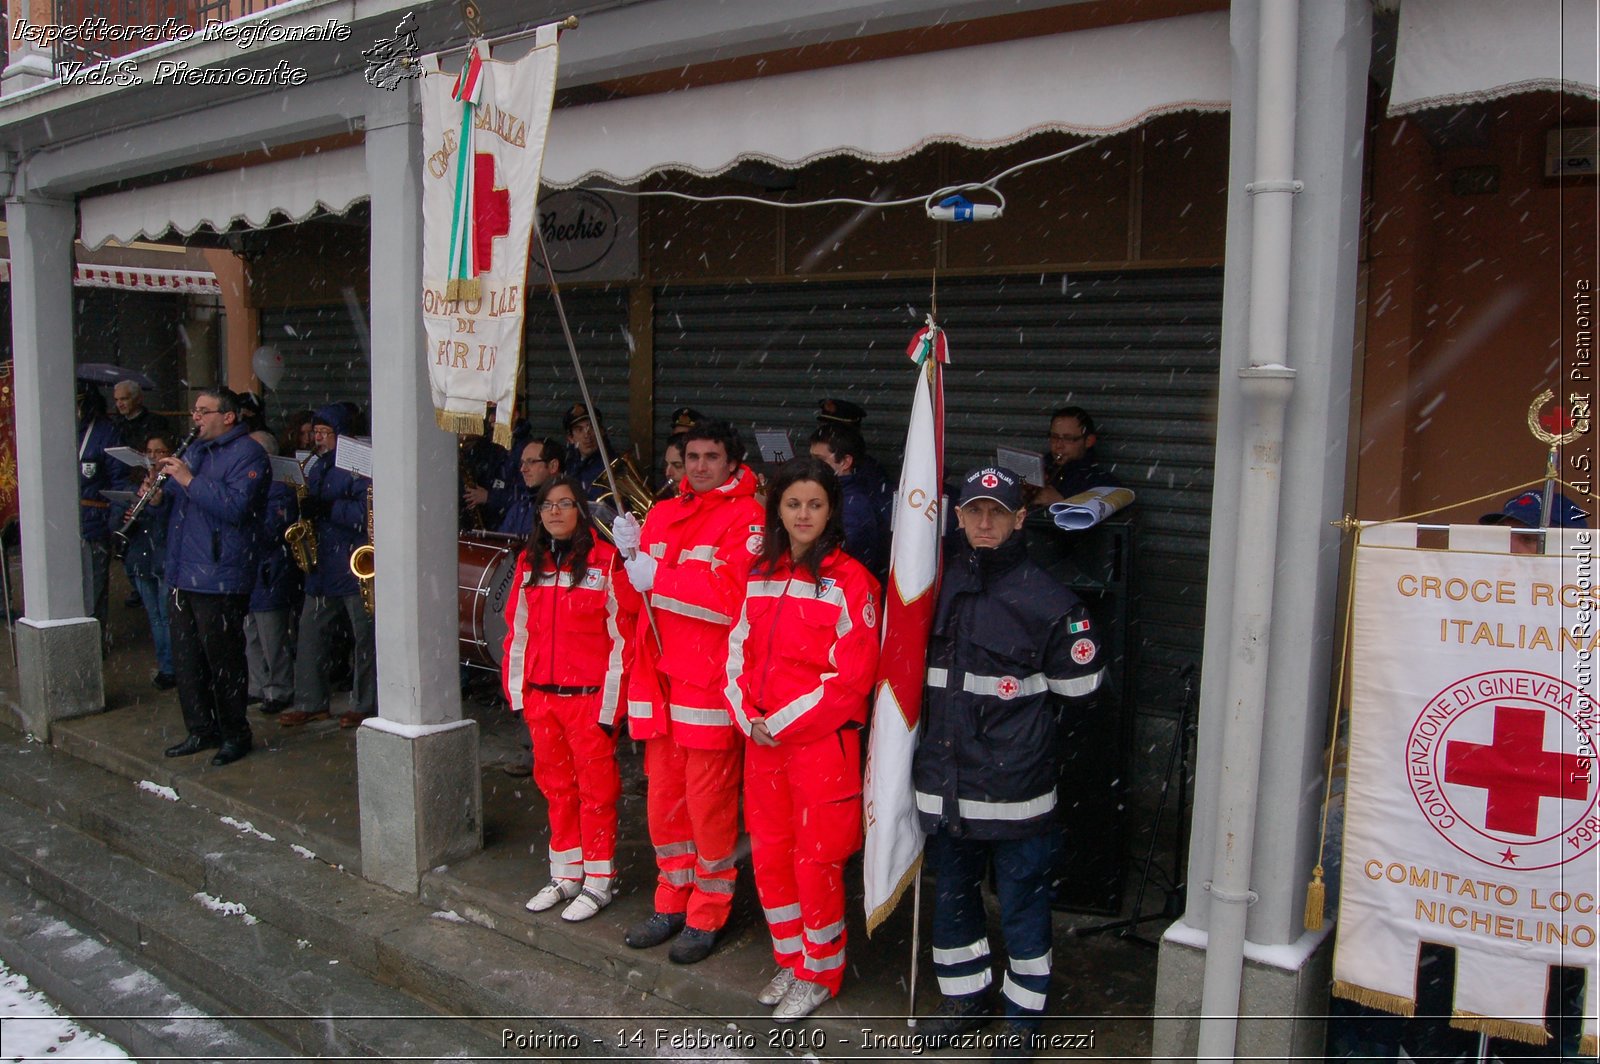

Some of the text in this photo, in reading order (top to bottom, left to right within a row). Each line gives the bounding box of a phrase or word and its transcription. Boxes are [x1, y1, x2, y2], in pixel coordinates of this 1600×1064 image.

[456, 317, 476, 334] DI
[1397, 574, 1516, 604] CROCE
[1411, 698, 1457, 830] CONVENZIONE
[1453, 685, 1475, 706] DI
[1478, 677, 1574, 710] GINEVRA
[1364, 858, 1600, 914] COMITATO LOC
[1415, 898, 1596, 948] NICHELINO
